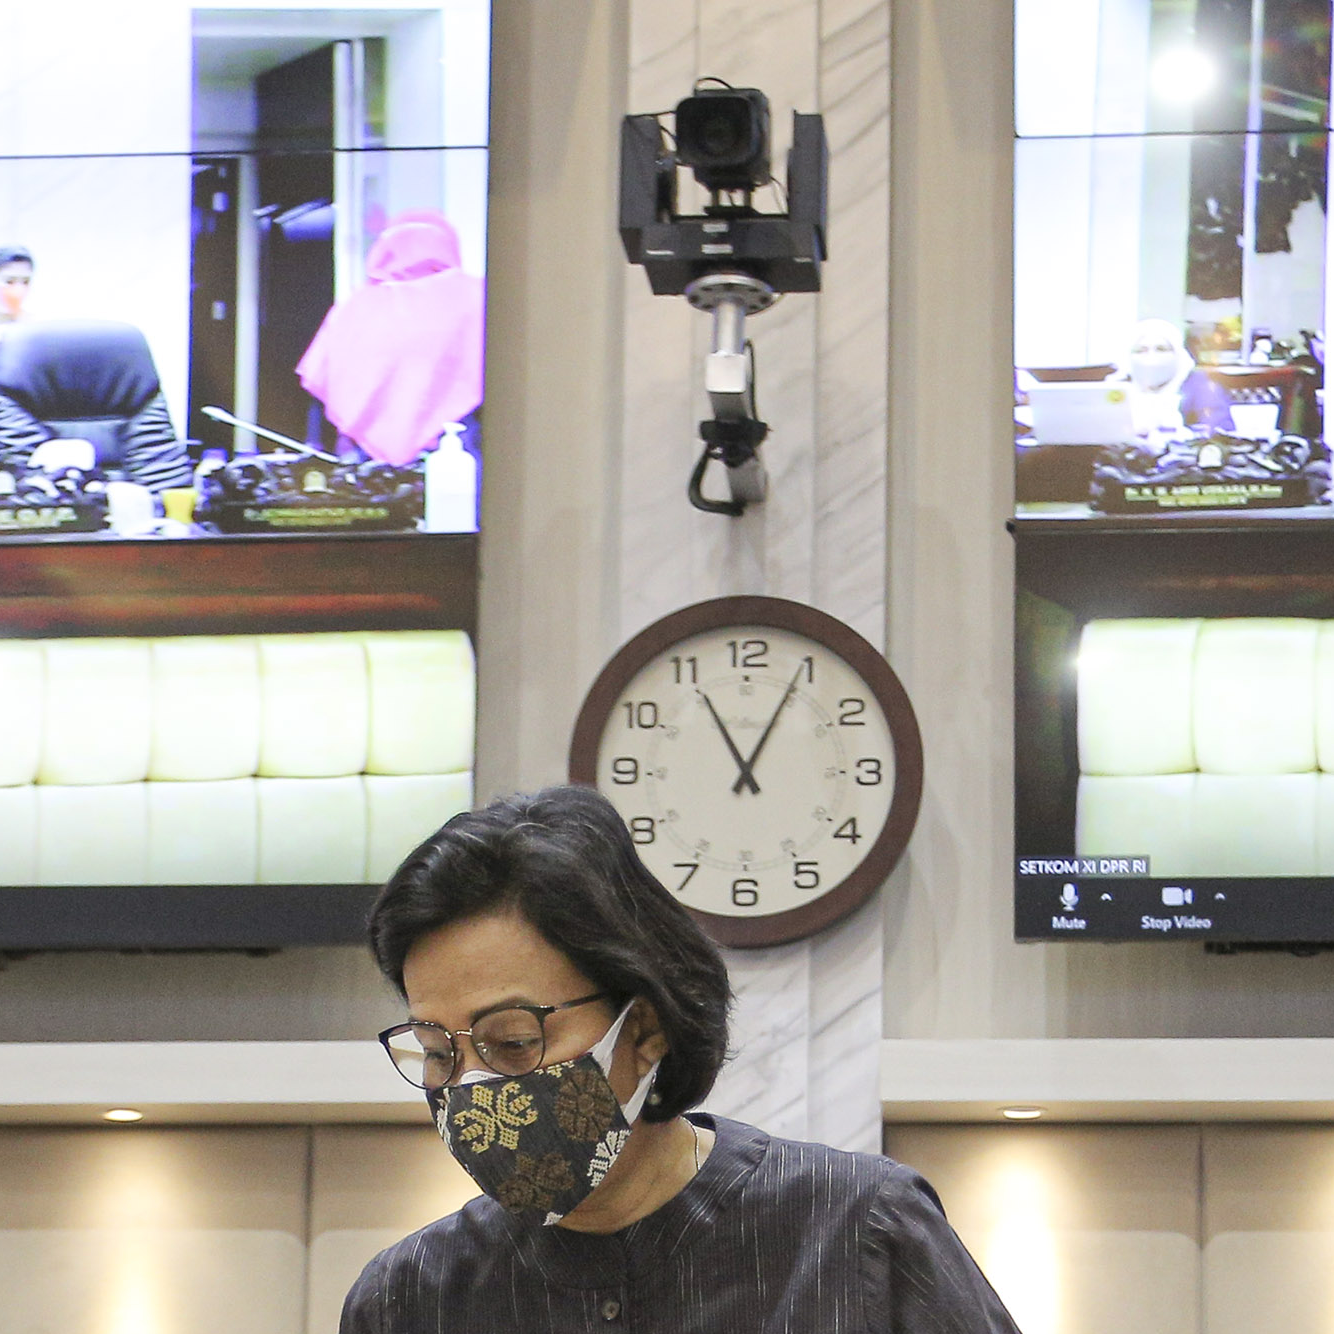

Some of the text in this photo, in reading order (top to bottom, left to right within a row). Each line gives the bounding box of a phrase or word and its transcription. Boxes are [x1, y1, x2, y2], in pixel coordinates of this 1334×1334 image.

[727, 640, 768, 668] 12
[670, 656, 698, 684] 11
[803, 656, 814, 683] 1
[623, 702, 659, 728] 10
[838, 698, 865, 726] 2
[612, 757, 638, 785] 9
[855, 758, 882, 786] 3
[630, 817, 655, 844] 8
[833, 817, 861, 844] 4
[673, 863, 699, 890] 7
[793, 861, 819, 889] 5
[1019, 860, 1147, 875] SETKOM XI DPR RI
[731, 879, 758, 906] 6
[1052, 915, 1086, 929] Mute
[1141, 915, 1212, 931] Stop Video
